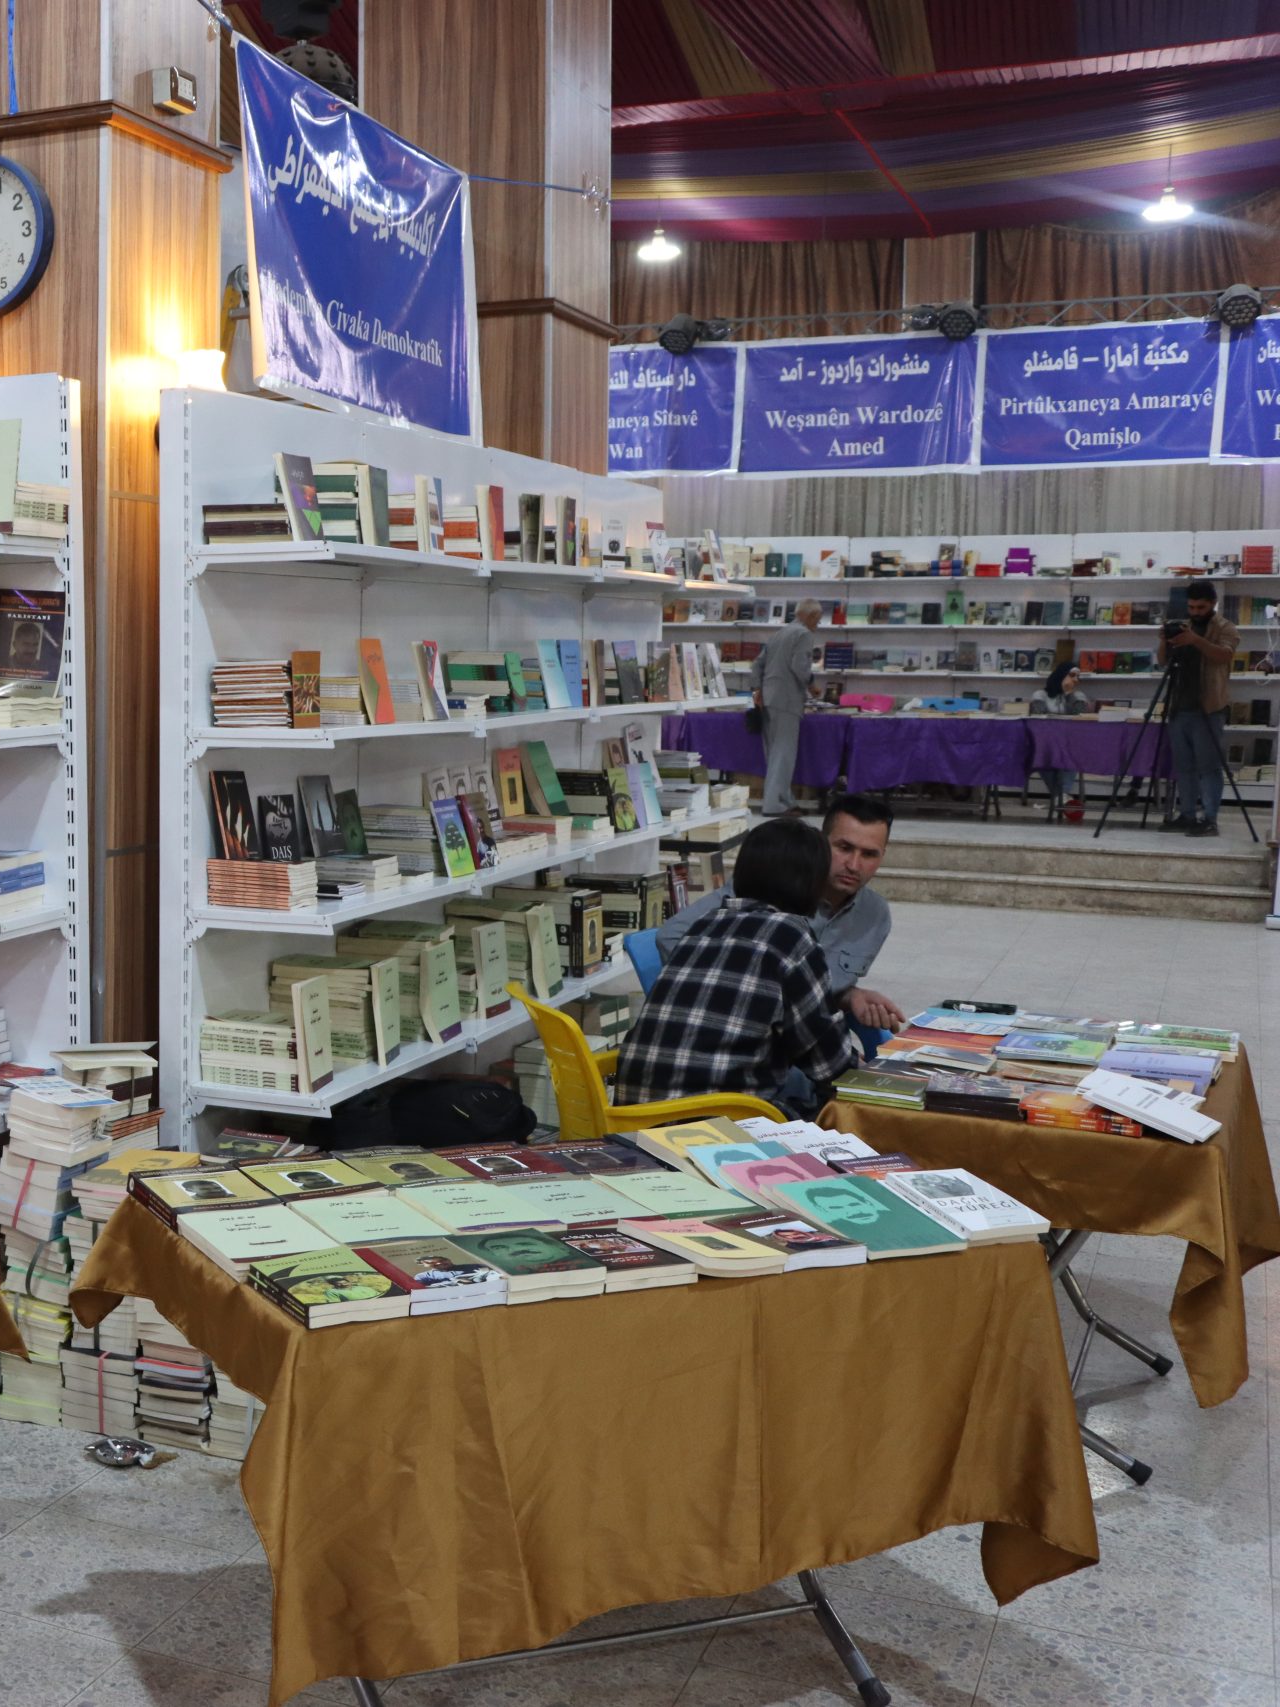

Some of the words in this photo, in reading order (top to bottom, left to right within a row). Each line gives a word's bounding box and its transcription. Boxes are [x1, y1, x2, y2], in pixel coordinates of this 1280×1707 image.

[13, 193, 23, 211] 2
[22, 220, 32, 238] 3
[17, 252, 25, 265] 4
[0, 277, 8, 290] 5
[326, 299, 370, 342] Civaka
[372, 317, 443, 368] Demokratîk
[867, 354, 931, 380] منشورات
[1023, 346, 1079, 378] قامشلو
[1103, 343, 1139, 373] أمارا
[1144, 341, 1190, 371] مكتبة
[677, 366, 697, 392] دار
[780, 356, 804, 383] آمد
[820, 356, 863, 385] واردوز
[1000, 393, 1120, 416] Pirtûkxaneya
[1126, 387, 1213, 413] Amarayê
[653, 410, 699, 428] Sîtavê
[765, 406, 850, 432] Weşanên
[856, 403, 944, 425] Wardozê
[827, 437, 885, 457] Amed
[1065, 427, 1141, 450] Qamişlo
